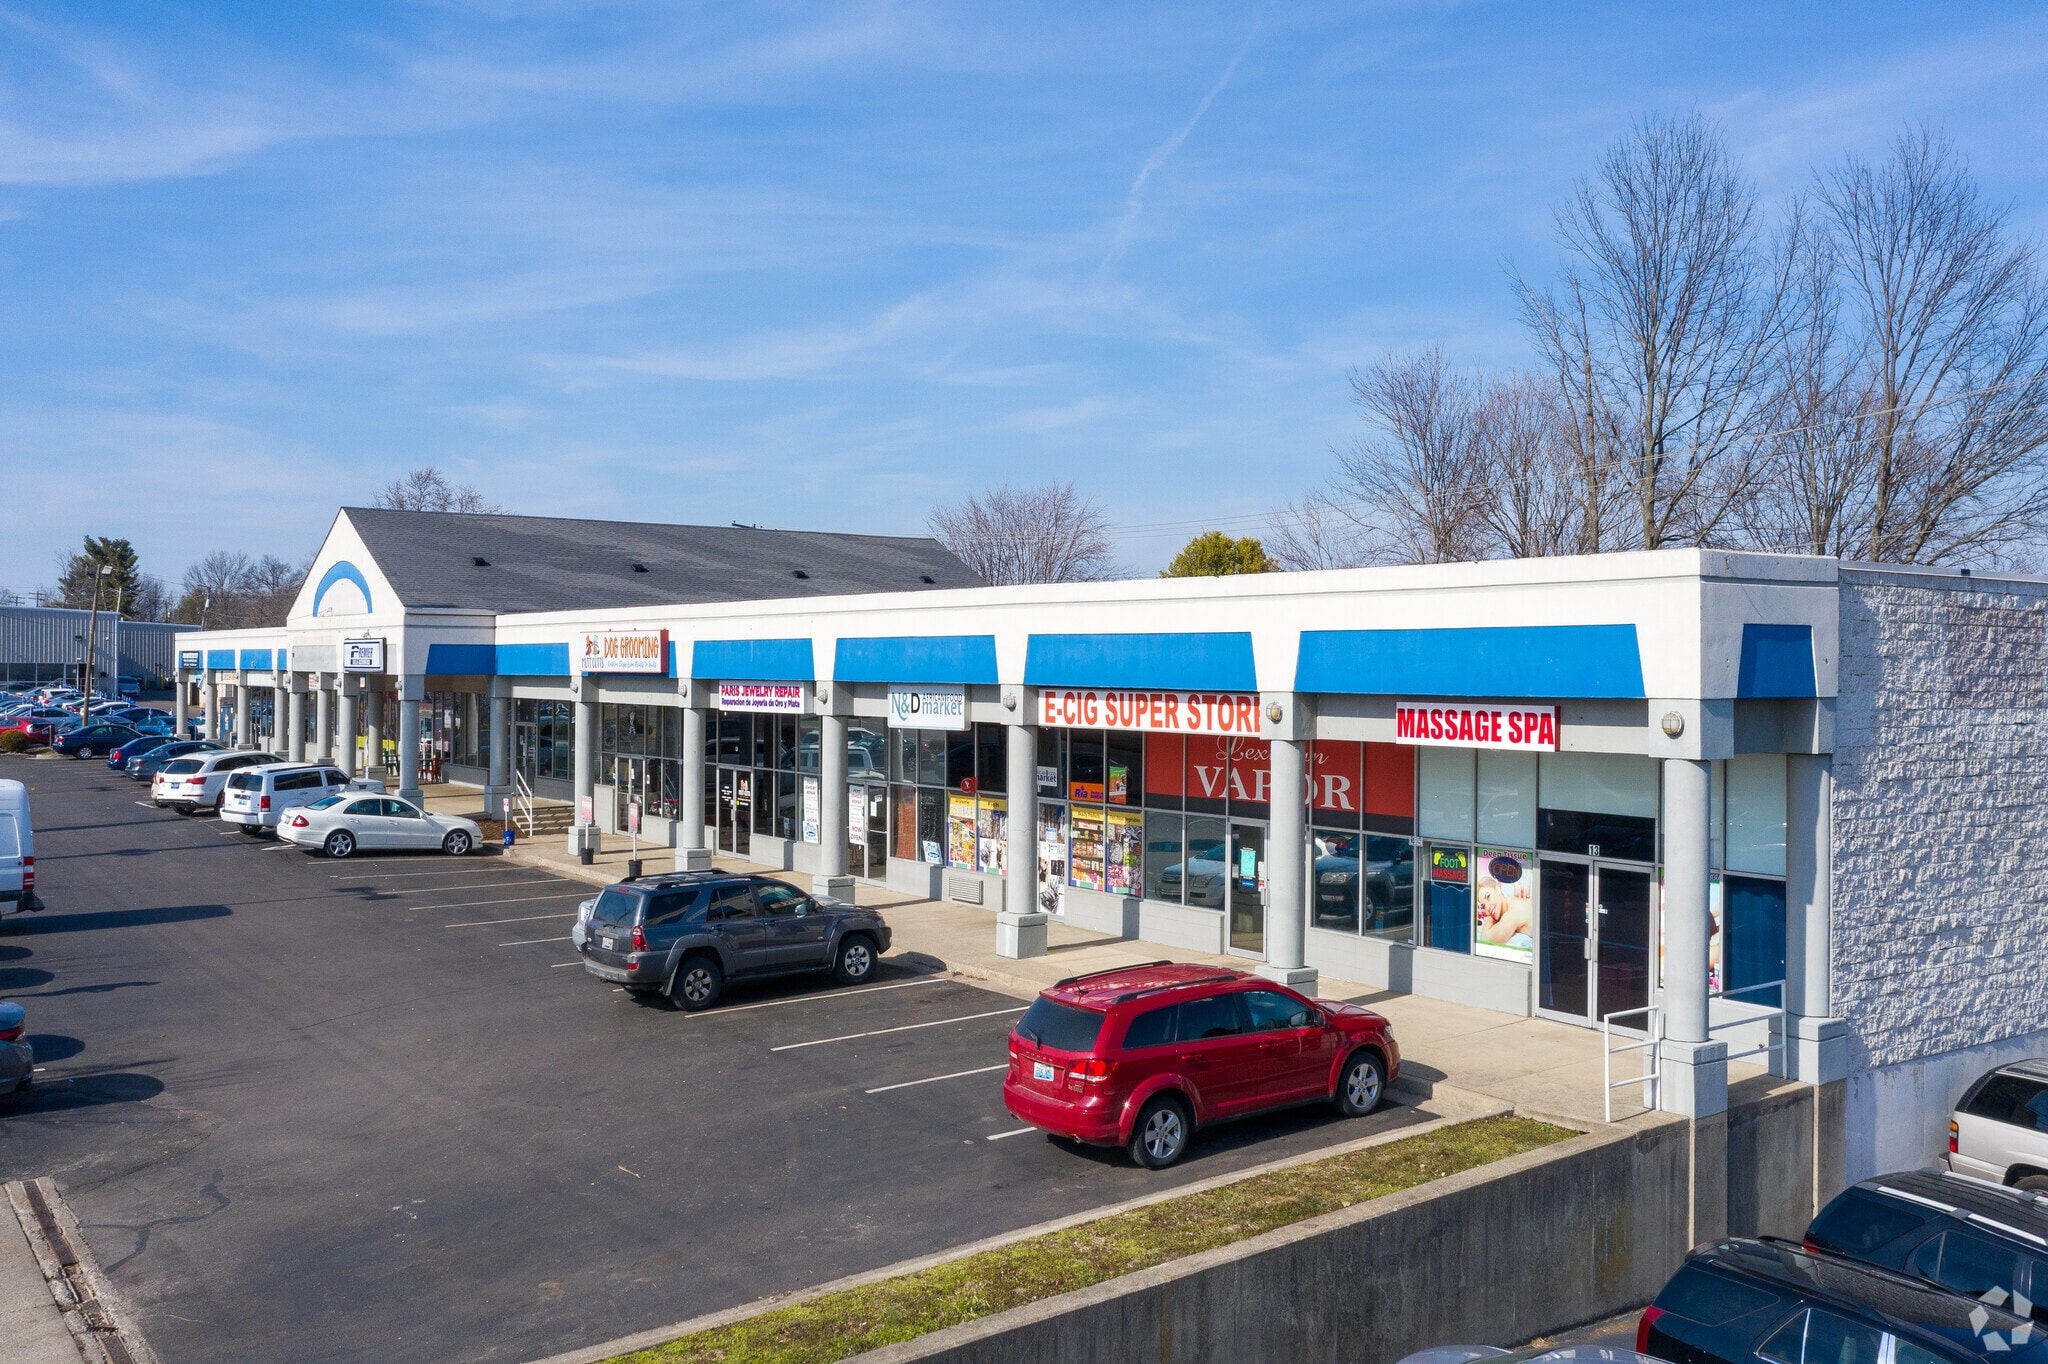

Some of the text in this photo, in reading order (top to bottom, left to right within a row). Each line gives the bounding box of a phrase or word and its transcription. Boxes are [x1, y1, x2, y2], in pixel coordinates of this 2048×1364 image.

[604, 636, 659, 658] DOG GROOMING
[721, 685, 800, 698] PARIS JEWELRY REPAIR
[922, 693, 962, 703] AFRICAN FOOD
[891, 692, 920, 721] N&D
[922, 695, 962, 716] market
[1045, 691, 1098, 726] E-CIG
[1105, 692, 1180, 728] SUPER
[1397, 708, 1555, 745] MASSAGE SPA
[1075, 786, 1088, 798] Ria
[1503, 851, 1527, 860] Tissue
[1590, 845, 1600, 856] 13
[1440, 857, 1460, 869] FOOT
[1432, 868, 1467, 881] MASSAGE
[1492, 863, 1521, 878] OPEN
